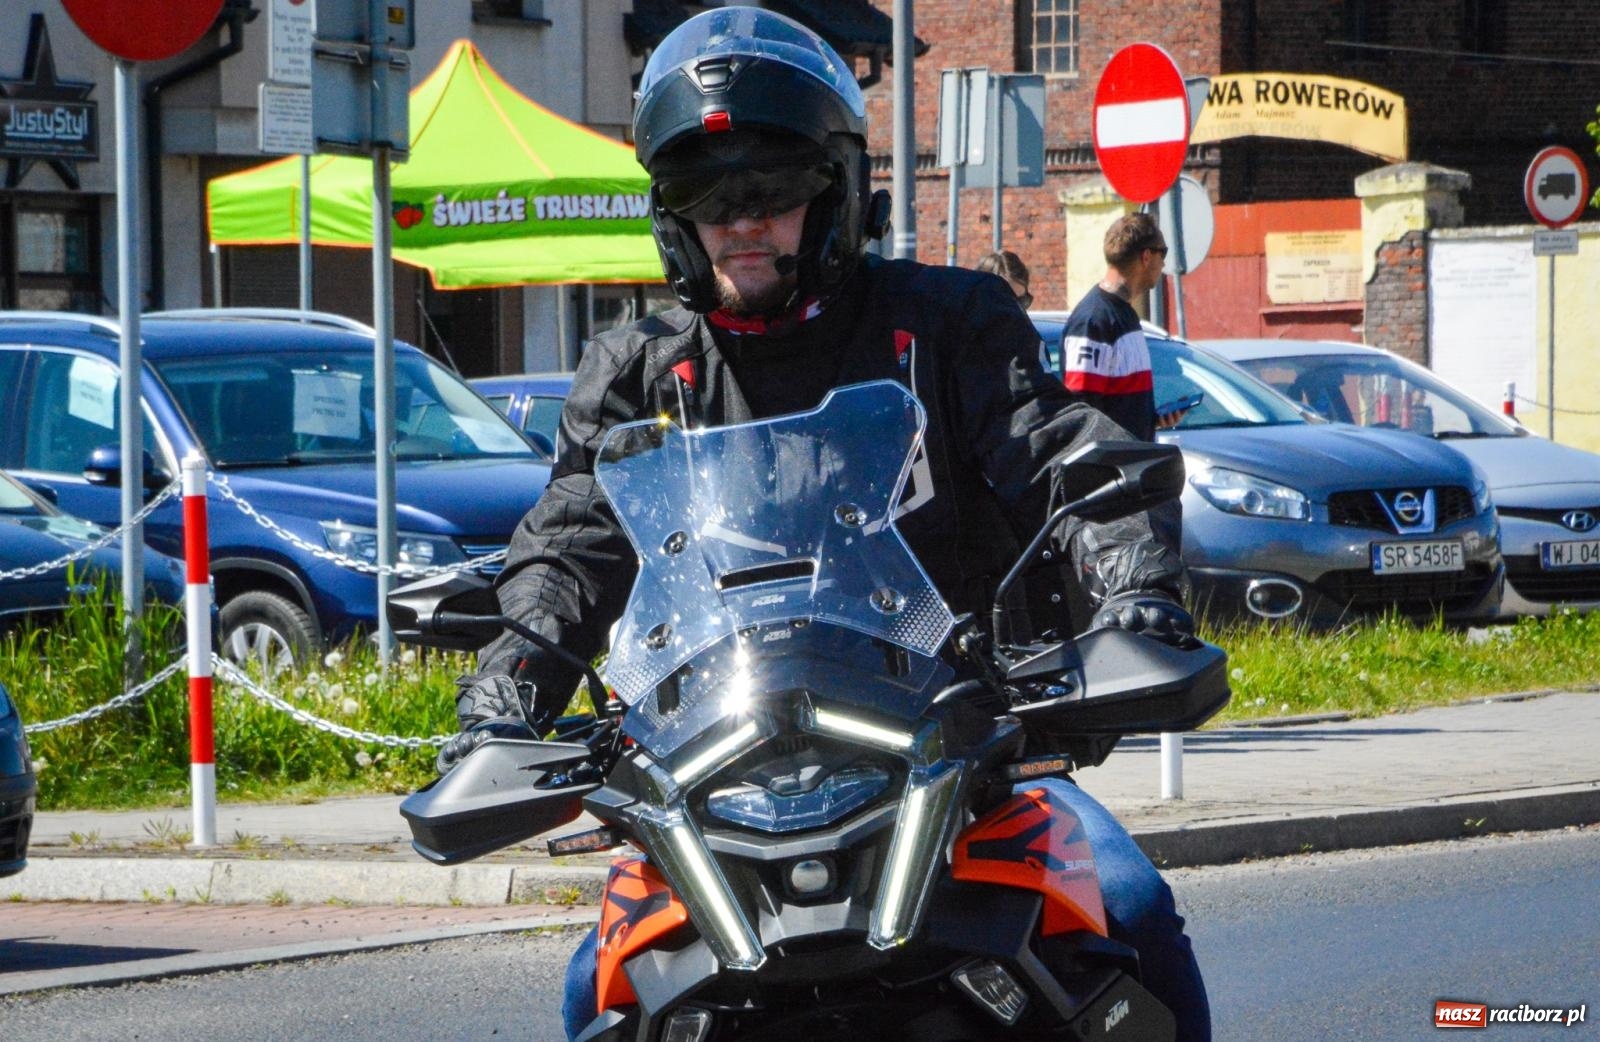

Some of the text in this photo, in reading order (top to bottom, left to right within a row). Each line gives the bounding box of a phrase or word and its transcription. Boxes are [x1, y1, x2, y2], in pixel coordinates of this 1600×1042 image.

[1255, 80, 1395, 120] ROWERÓW
[4, 104, 89, 140] JustyStyl
[433, 189, 526, 227] ŚWIEŻE
[1383, 543, 1459, 568] SR 5458F
[1553, 542, 1600, 565] WJ 04
[1105, 999, 1129, 1032] KTM
